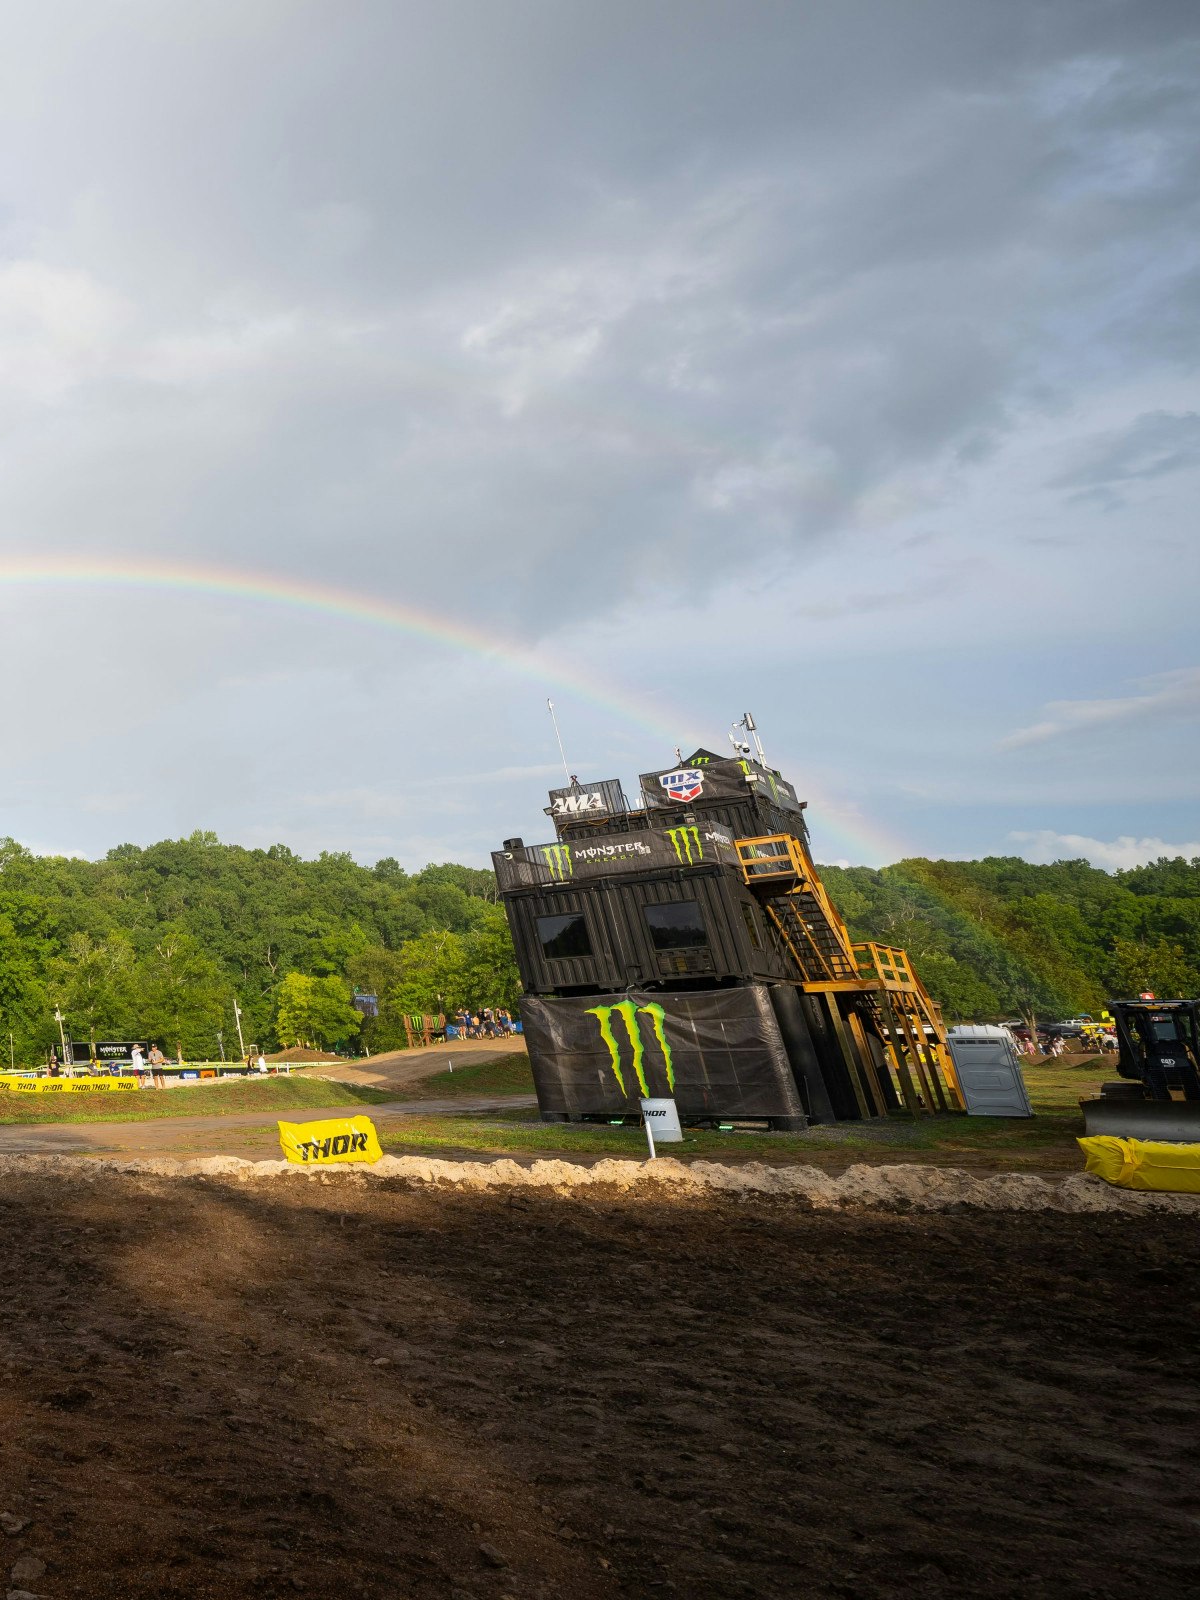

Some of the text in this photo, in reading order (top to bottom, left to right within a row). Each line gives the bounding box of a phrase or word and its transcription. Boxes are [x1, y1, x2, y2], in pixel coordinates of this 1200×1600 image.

[552, 792, 606, 813] AMA
[575, 841, 645, 859] MONSTER
[587, 854, 634, 864] ENERGY
[297, 1133, 368, 1160] THOR
